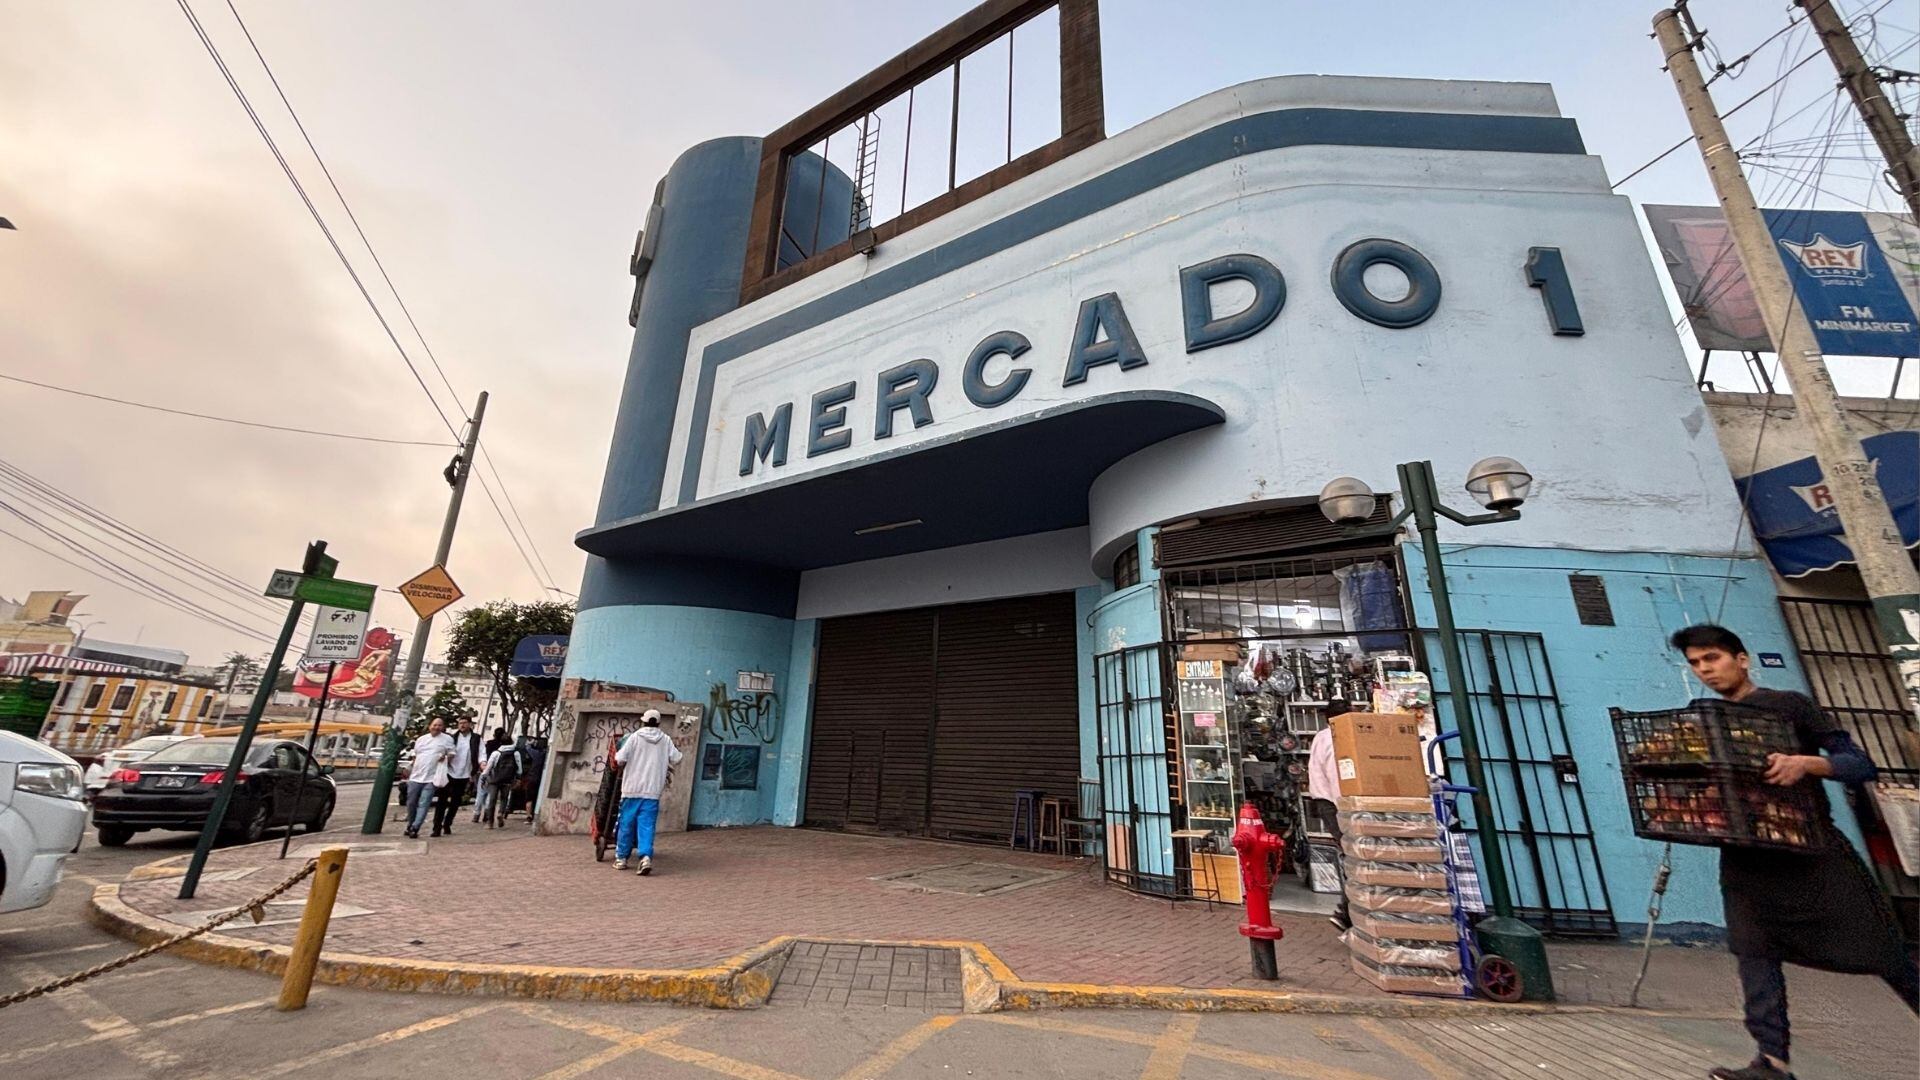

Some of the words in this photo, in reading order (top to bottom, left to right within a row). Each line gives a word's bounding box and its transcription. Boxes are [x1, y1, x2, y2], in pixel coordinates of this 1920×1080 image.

[1804, 249, 1856, 267] REY
[1840, 305, 1872, 319] FM
[1815, 320, 1912, 333] MINIMARKET
[738, 237, 1442, 478] MERCADO
[1524, 246, 1586, 338] 1
[407, 590, 453, 600] VELOCIDAD
[410, 583, 453, 594] DISMINUIR
[543, 646, 566, 656] REY
[1185, 660, 1215, 678] ENTRADA
